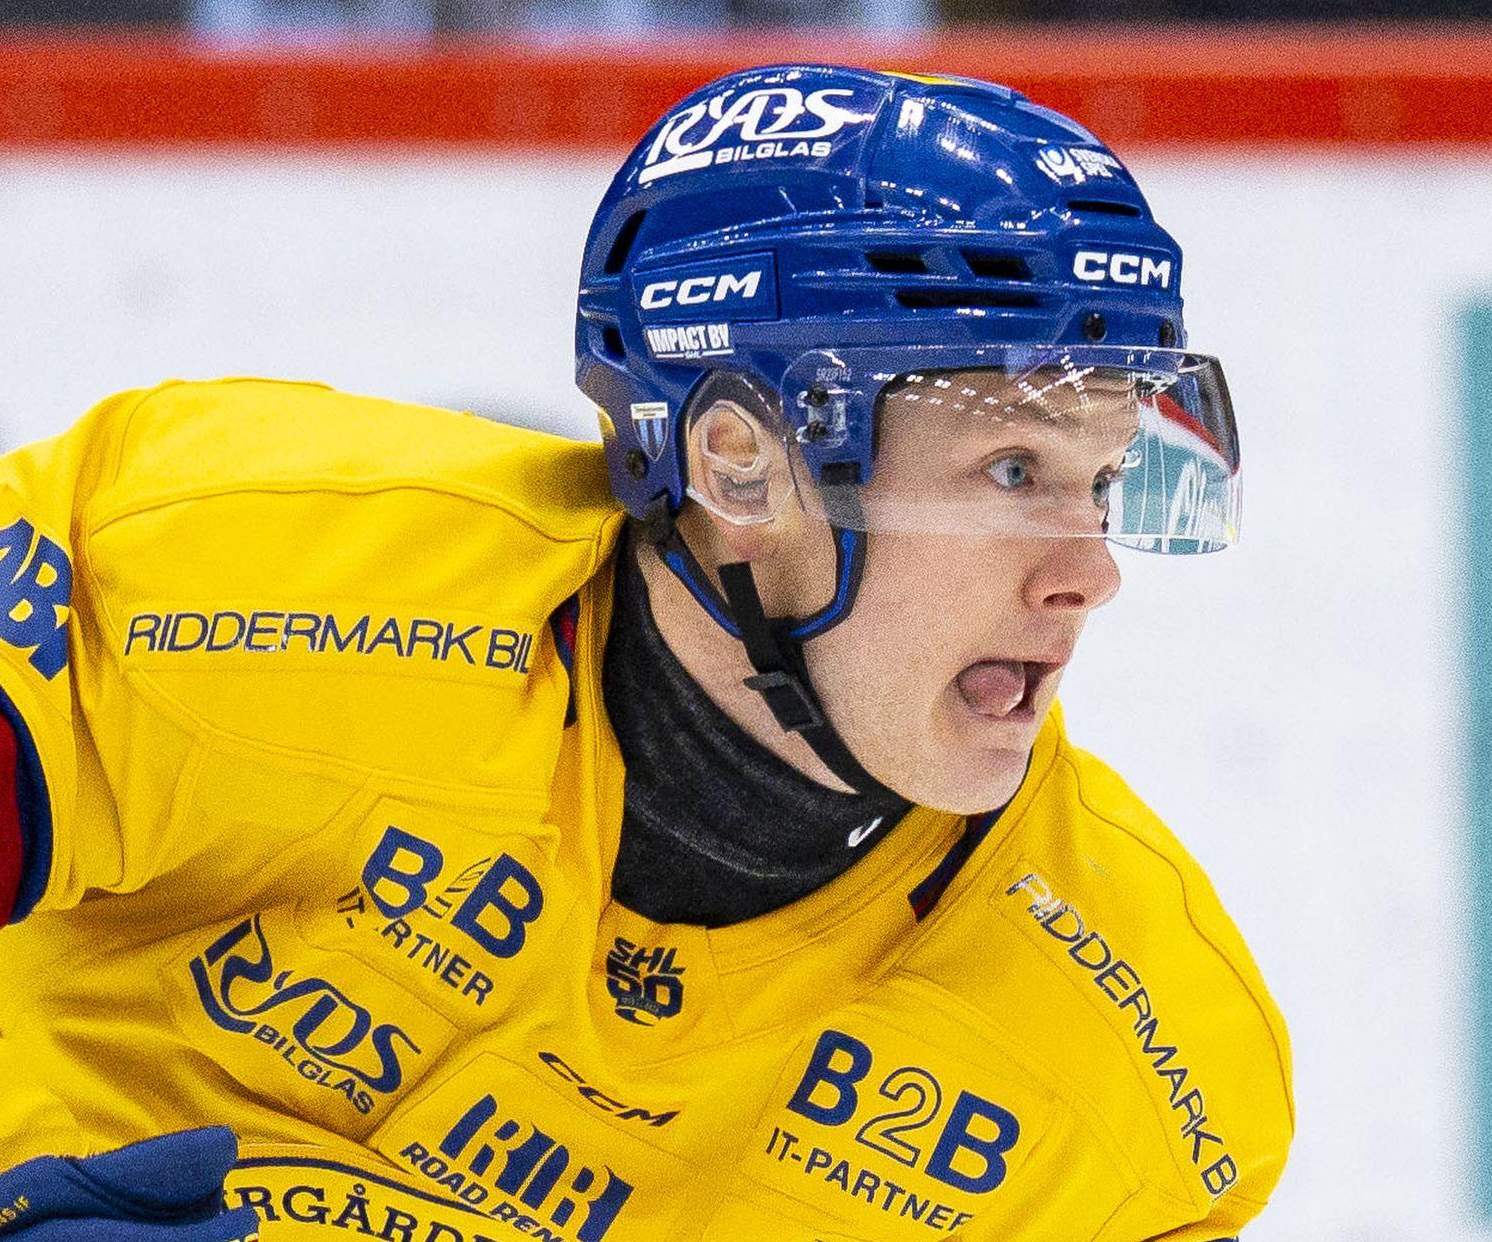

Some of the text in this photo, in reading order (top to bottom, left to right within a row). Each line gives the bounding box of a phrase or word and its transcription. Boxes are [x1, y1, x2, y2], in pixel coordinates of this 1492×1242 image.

[715, 141, 832, 165] BILGLAS
[640, 270, 763, 309] CCM
[1072, 250, 1172, 290] CCM
[646, 322, 730, 353] IMPACT BY
[124, 610, 484, 667] RIDDERMARK
[336, 885, 495, 1007] IT-RTNER
[1005, 872, 1239, 1197] RIDDERMARK B
[254, 1023, 376, 1116] BILGLAS
[537, 1051, 683, 1128] CCM
[785, 1028, 1022, 1196] B2B
[399, 1141, 489, 1206] ROAD
